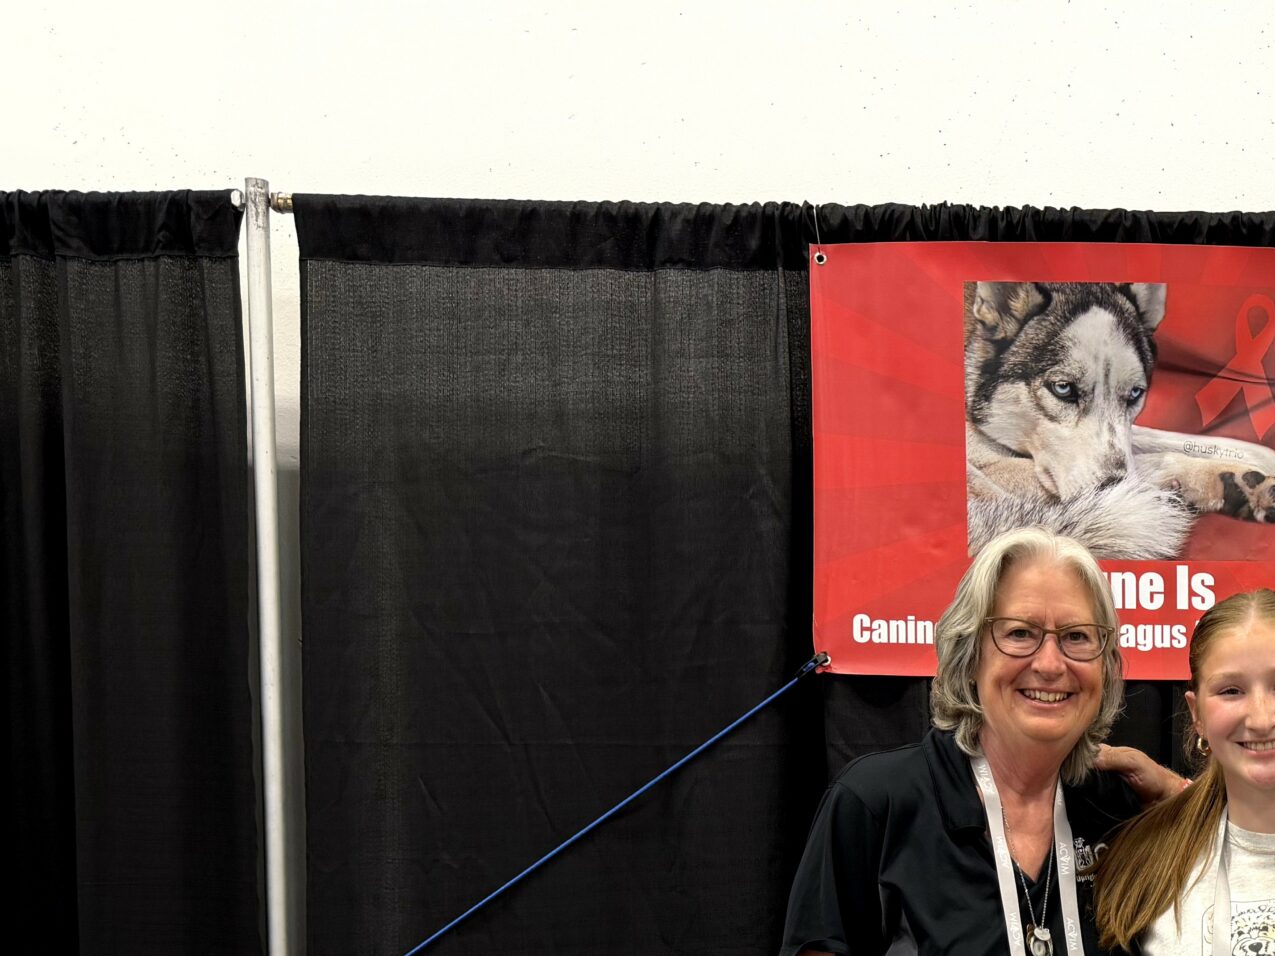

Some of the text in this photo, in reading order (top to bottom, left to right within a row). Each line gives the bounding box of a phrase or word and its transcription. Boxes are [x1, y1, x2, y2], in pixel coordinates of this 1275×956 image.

[1183, 440, 1245, 459] @huskytrio
[1103, 565, 1216, 610] ne Is
[852, 613, 938, 645] Canin
[1119, 623, 1187, 652] agus
[1066, 917, 1078, 952] ACVIM
